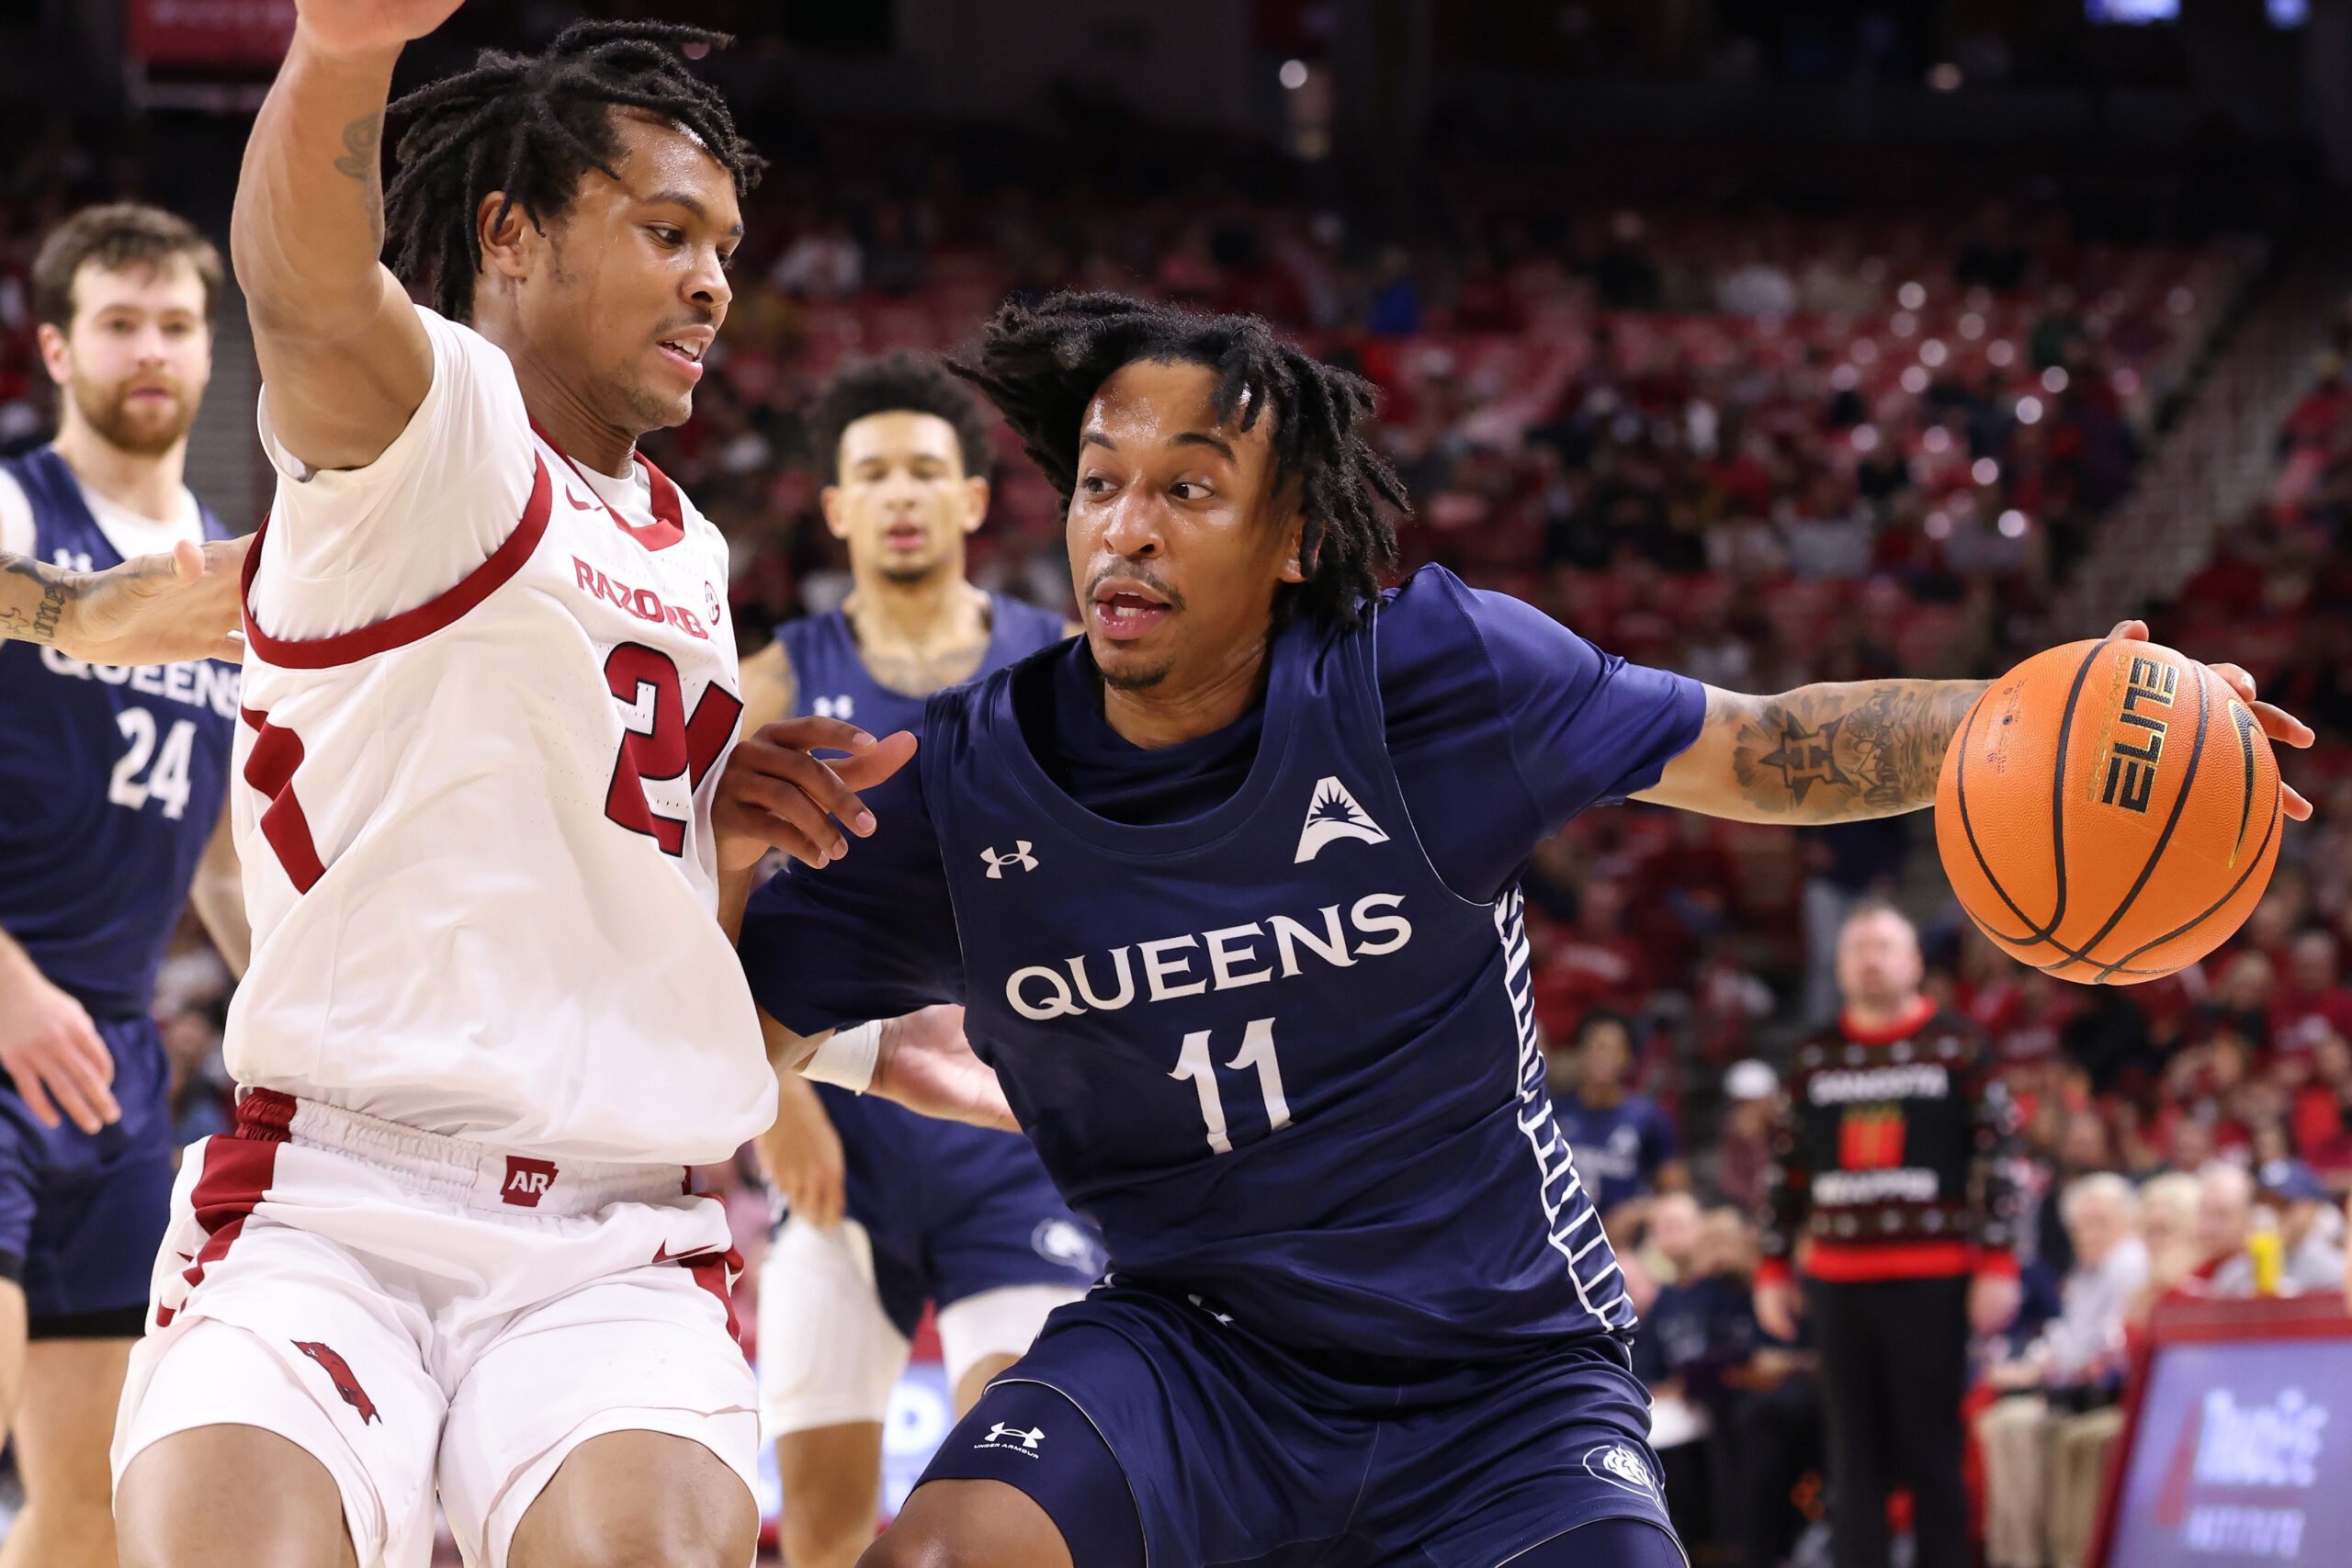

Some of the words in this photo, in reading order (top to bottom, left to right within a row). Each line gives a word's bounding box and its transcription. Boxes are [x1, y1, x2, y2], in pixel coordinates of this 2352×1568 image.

[107, 706, 197, 821] 24
[2101, 656, 2179, 815] ELITE
[1005, 892, 1413, 1021] QUEENS
[1166, 1016, 1296, 1156] 11
[507, 1169, 549, 1196] AR
[1001, 1442, 1039, 1460] ARMOUR
